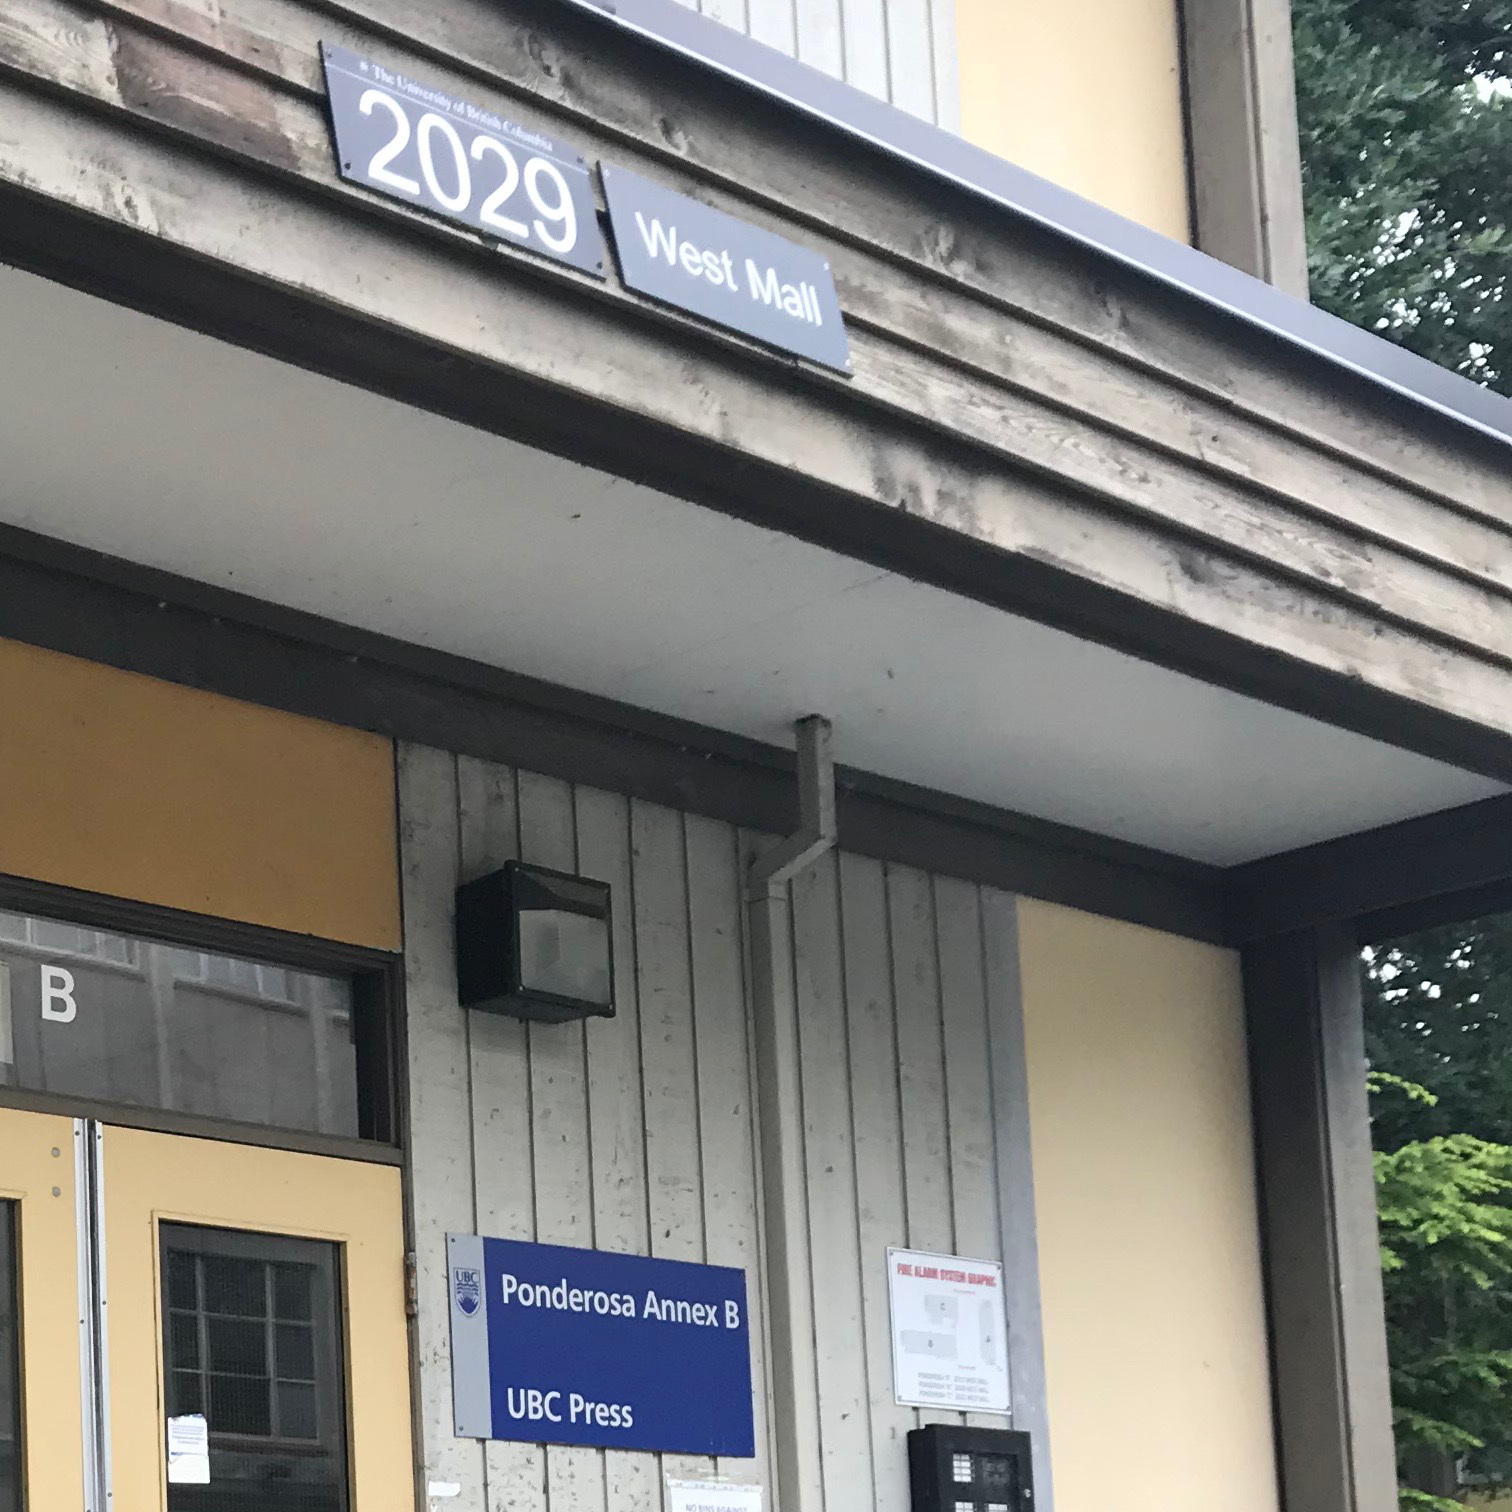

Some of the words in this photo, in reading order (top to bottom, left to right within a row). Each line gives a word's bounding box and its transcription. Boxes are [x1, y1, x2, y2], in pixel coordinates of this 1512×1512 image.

[359, 89, 577, 254] 2029
[635, 211, 739, 292] West
[745, 258, 823, 327] Mall
[40, 963, 77, 1023] B
[455, 1269, 479, 1283] UBC
[501, 1273, 636, 1318] Ponderosa
[642, 1290, 719, 1328] Annex
[724, 1300, 740, 1330] B
[507, 1387, 562, 1422] UBC
[569, 1393, 634, 1428] Press
[685, 1503, 697, 1512] NO
